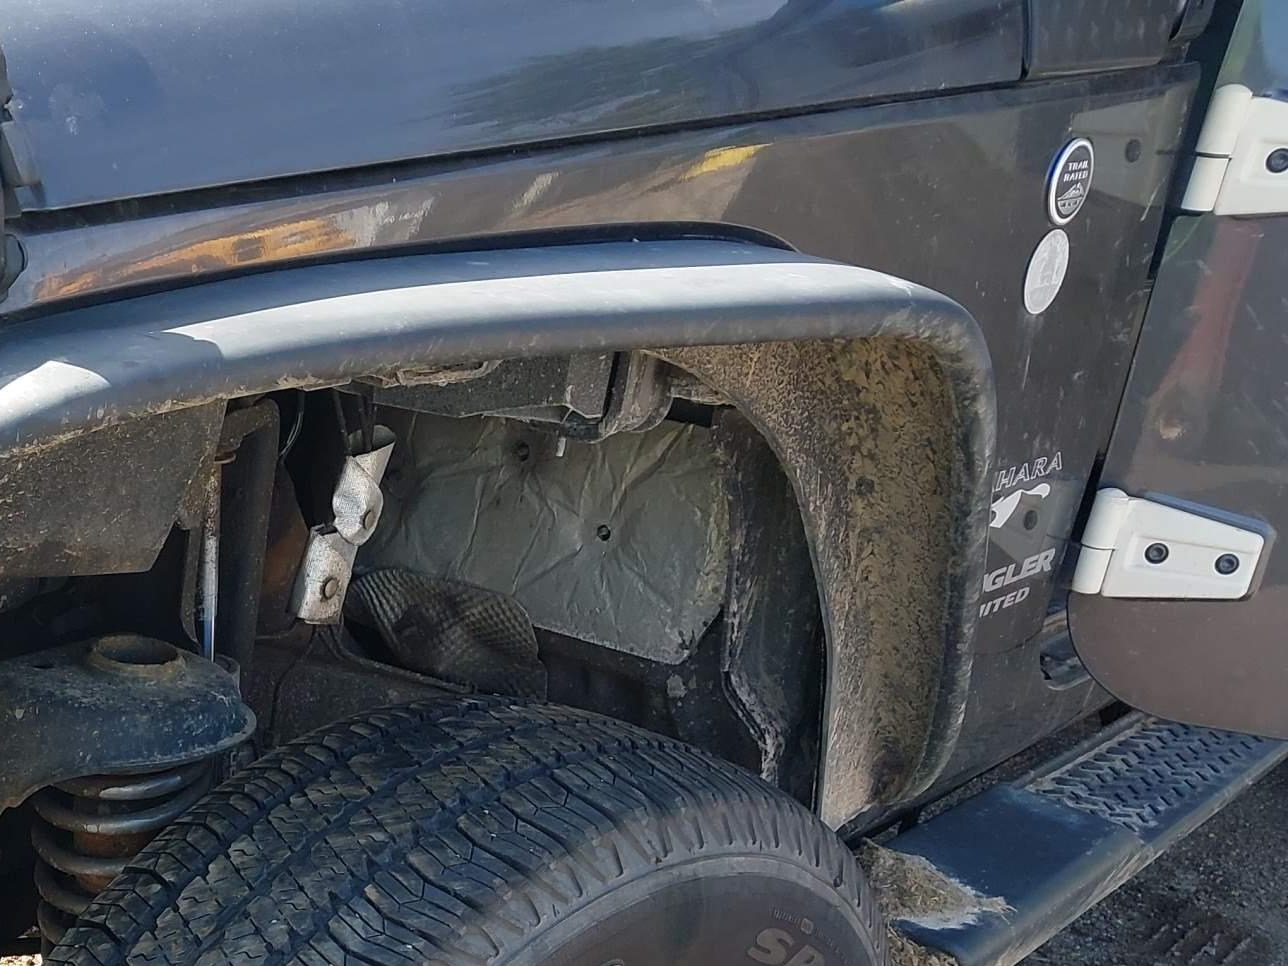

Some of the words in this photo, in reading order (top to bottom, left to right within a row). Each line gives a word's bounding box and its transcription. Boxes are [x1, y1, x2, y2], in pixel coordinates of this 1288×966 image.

[1063, 171, 1089, 182] RATED
[1067, 160, 1089, 171] TRAIL
[992, 451, 1062, 493] HARA
[982, 547, 1056, 594] GLER
